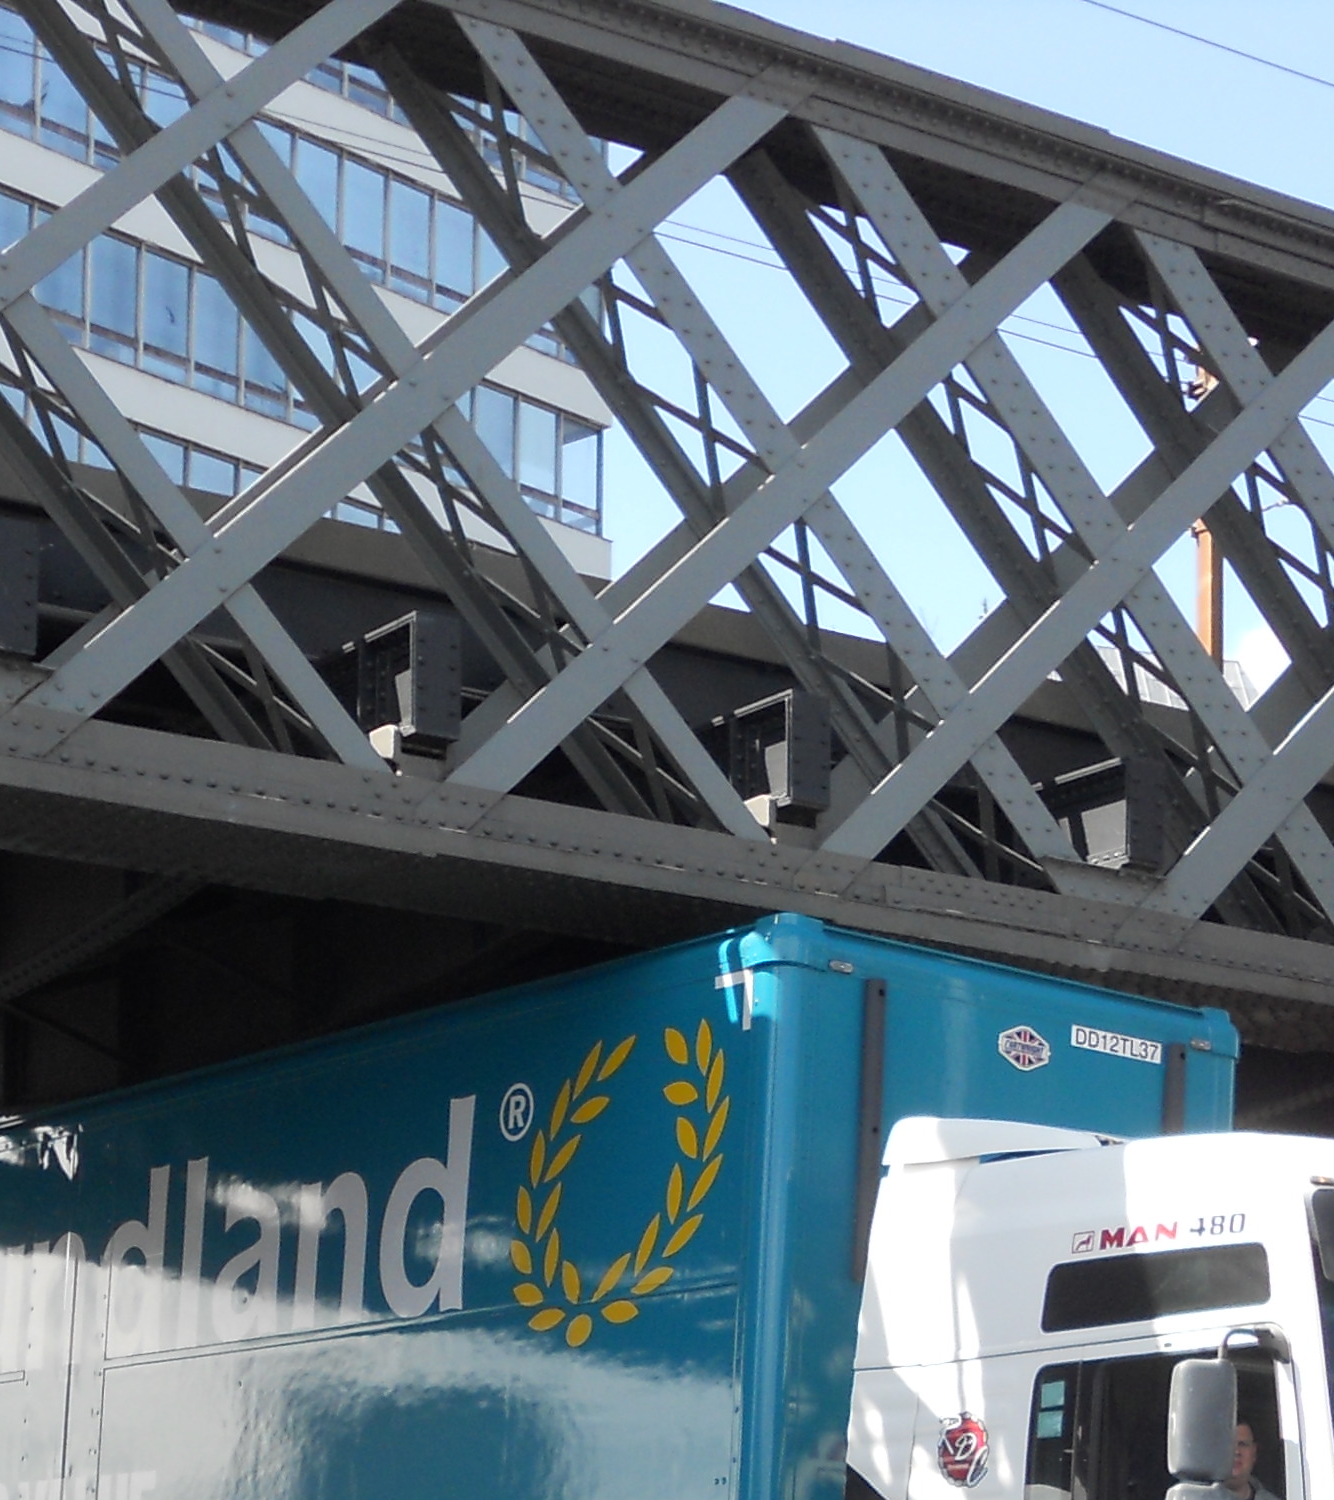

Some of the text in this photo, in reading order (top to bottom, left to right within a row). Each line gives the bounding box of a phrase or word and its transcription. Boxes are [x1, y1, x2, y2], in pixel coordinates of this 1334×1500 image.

[1075, 1028, 1160, 1061] DD12TL37
[1099, 1213, 1246, 1250] MAN 480
